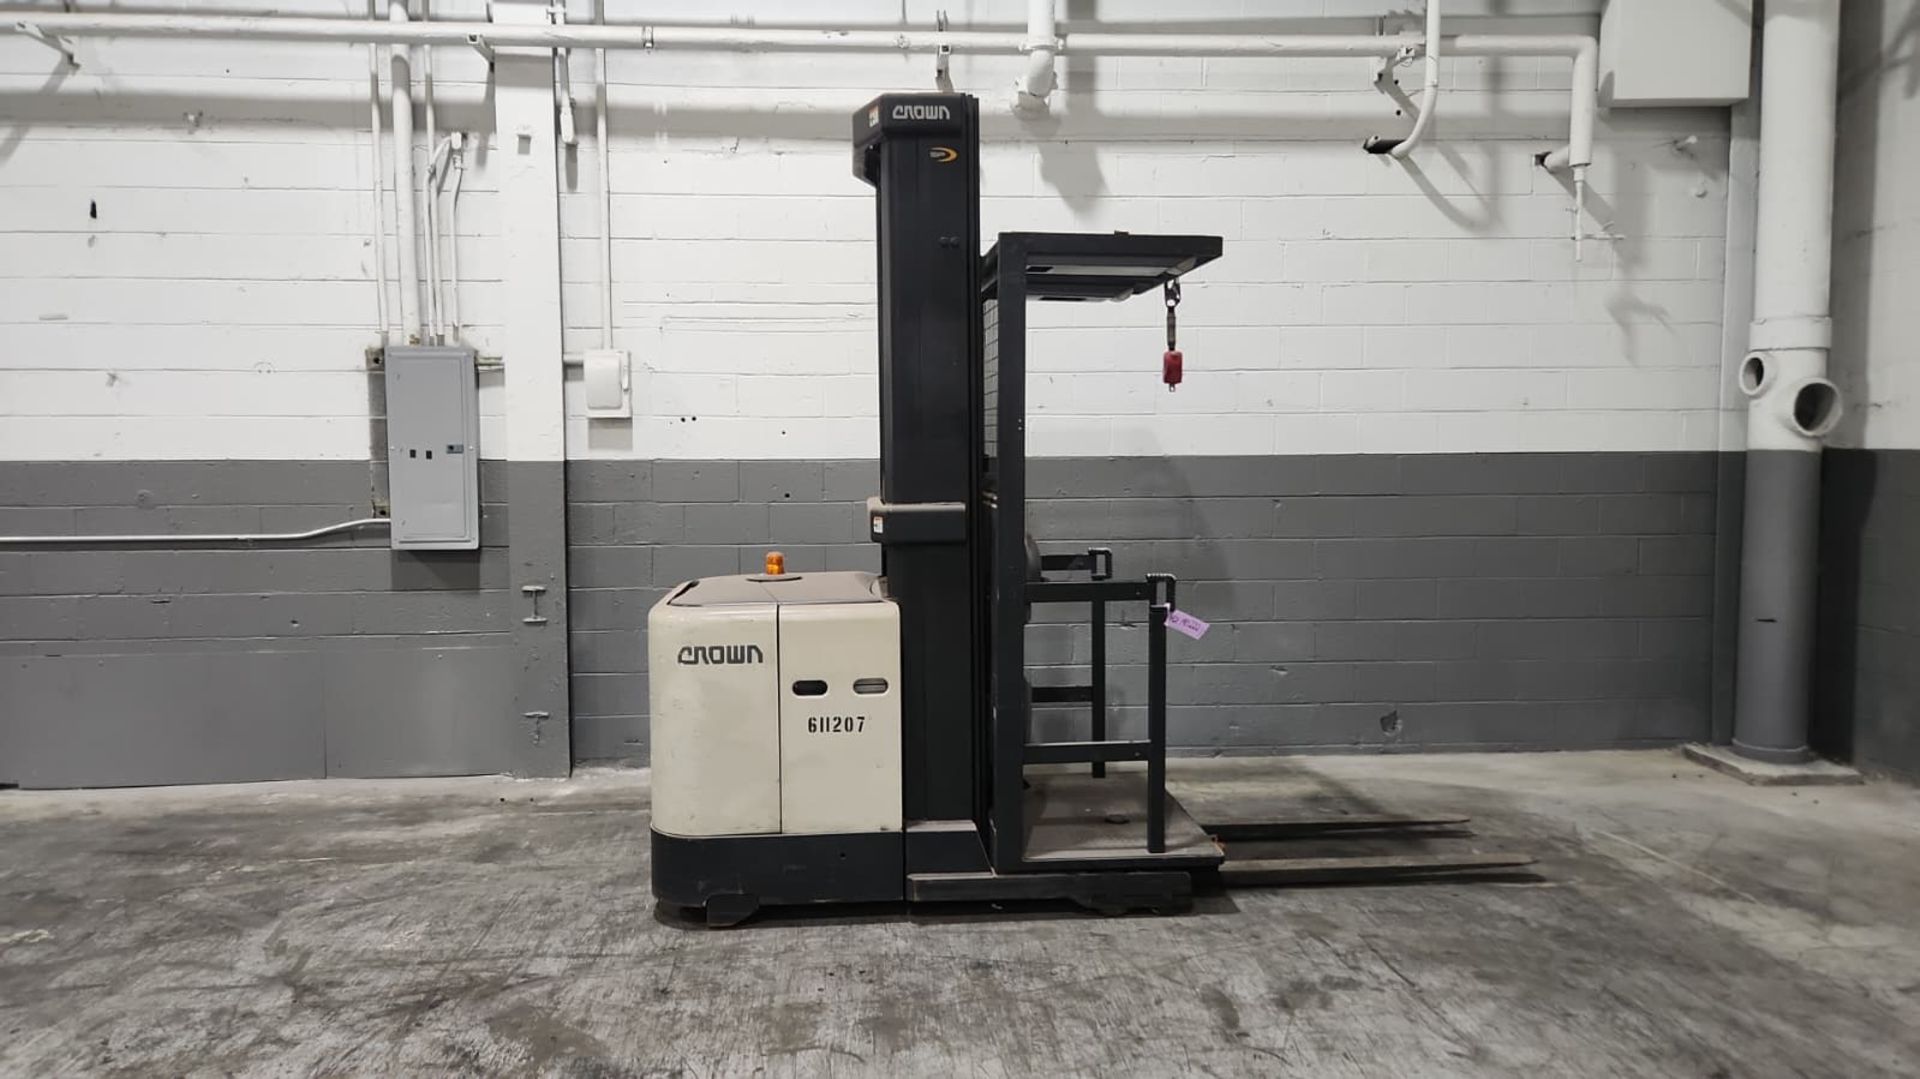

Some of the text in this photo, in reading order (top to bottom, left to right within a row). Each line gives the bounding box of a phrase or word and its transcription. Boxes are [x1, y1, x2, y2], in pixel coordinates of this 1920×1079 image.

[892, 105, 951, 120] CROWN
[677, 645, 763, 665] CROWN
[808, 716, 865, 733] 611207
